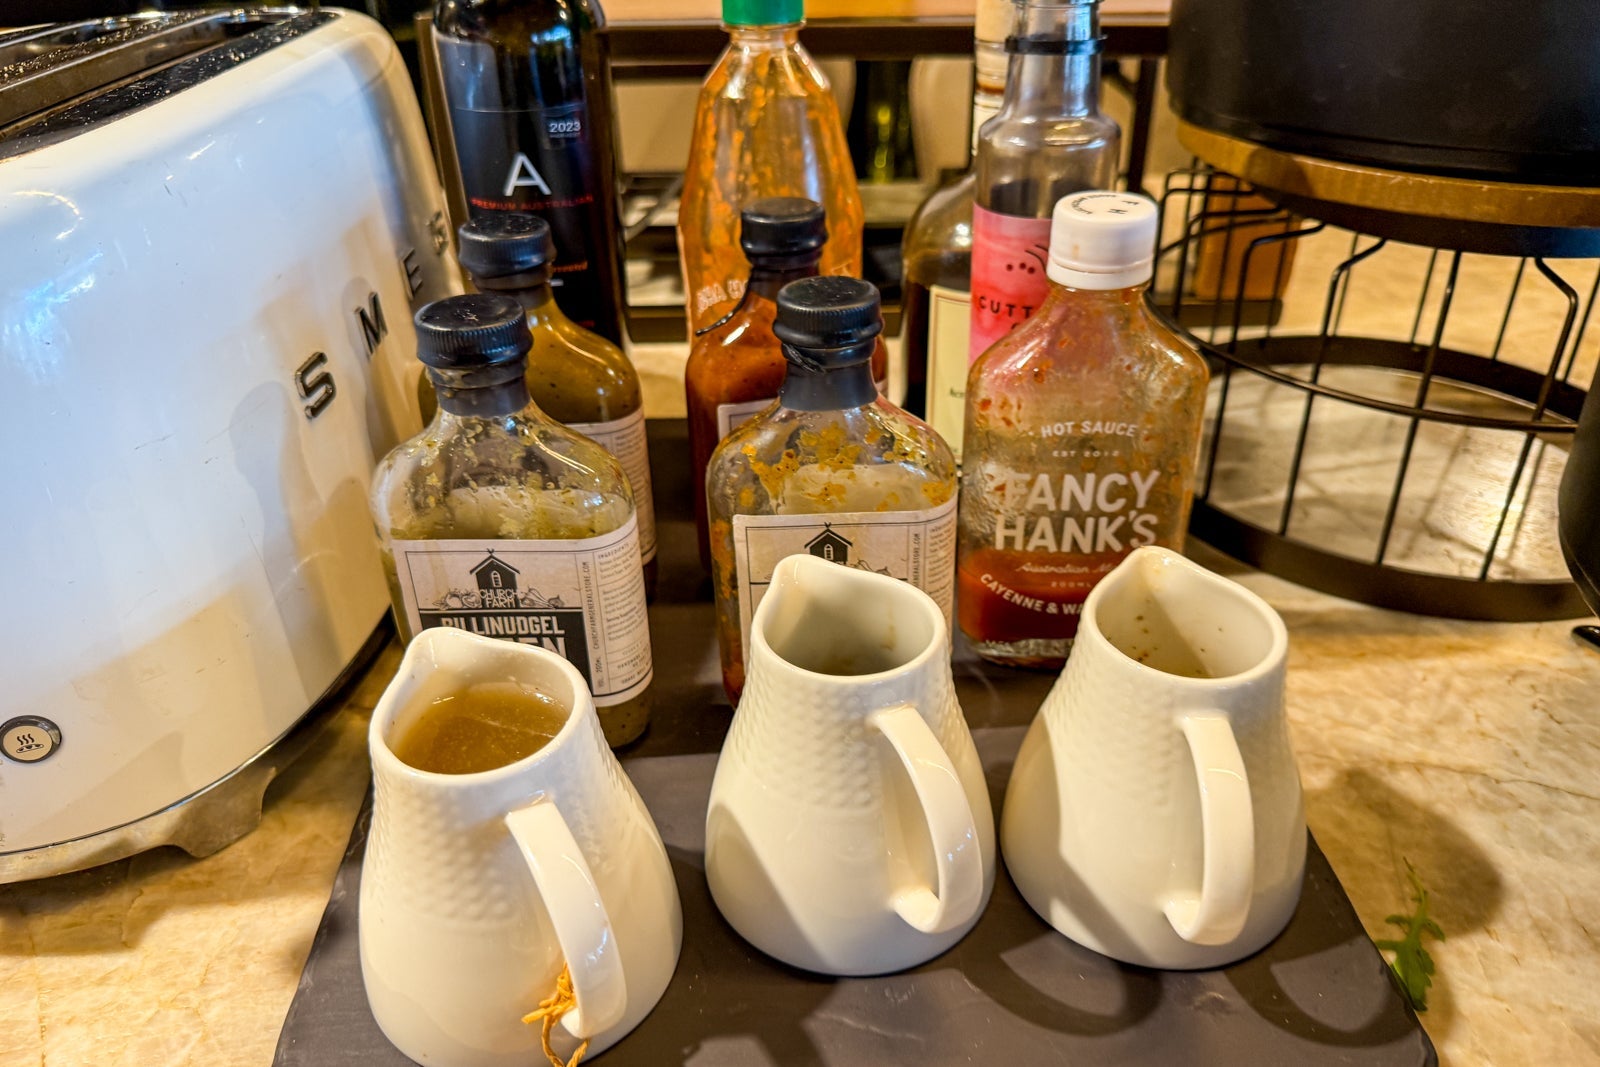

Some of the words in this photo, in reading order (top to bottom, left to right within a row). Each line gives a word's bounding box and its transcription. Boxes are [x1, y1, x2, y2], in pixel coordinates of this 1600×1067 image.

[549, 121, 581, 132] 2023
[504, 153, 552, 196] A
[978, 296, 1034, 319] CUTT
[1041, 421, 1075, 438] HOT
[1081, 420, 1138, 437] SAUCE
[1002, 469, 1161, 513] FANCY
[994, 509, 1159, 554] HANK'S
[479, 588, 518, 600] CHURCH
[485, 598, 516, 608] FARM
[980, 573, 1044, 612] CAYENNE
[1045, 602, 1059, 615] &
[1062, 603, 1085, 615] WA
